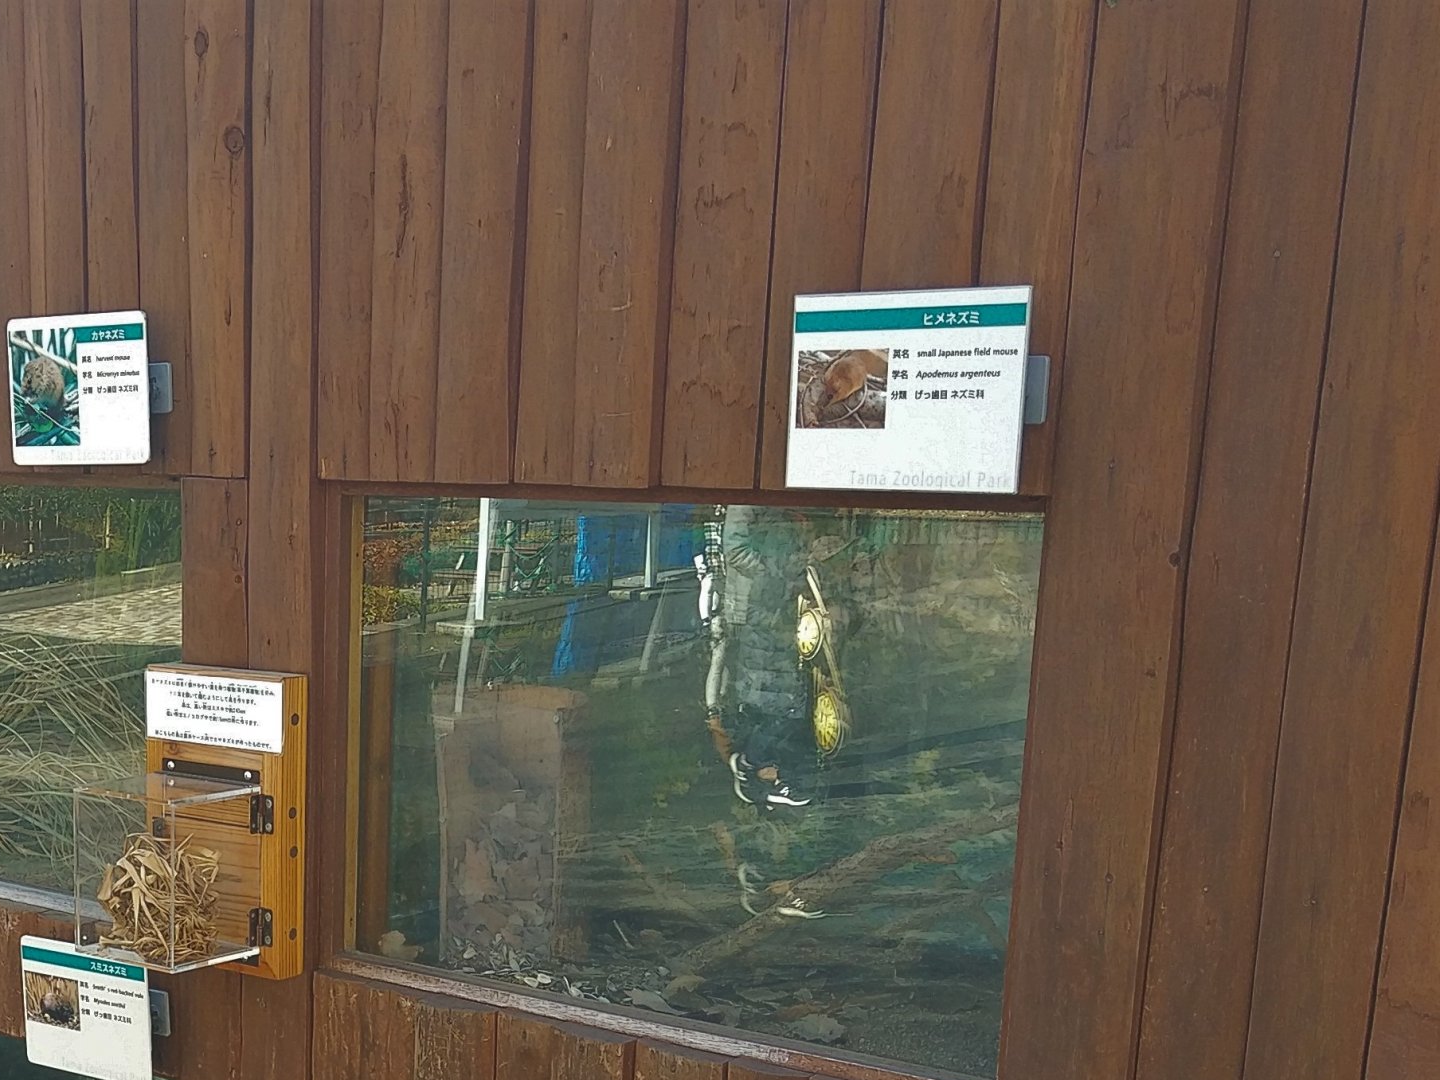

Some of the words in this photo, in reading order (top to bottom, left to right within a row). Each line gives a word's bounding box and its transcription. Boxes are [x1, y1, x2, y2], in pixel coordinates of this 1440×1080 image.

[923, 311, 980, 326] ヒメネズミ
[91, 328, 125, 341] カヤネズミ
[892, 349, 909, 359] 英名
[917, 348, 937, 358] small
[938, 348, 972, 359] Japanese
[974, 347, 991, 356] field
[993, 348, 1018, 356] mouse
[892, 370, 909, 379] 学名
[915, 369, 958, 380] Apodemus
[960, 369, 1001, 379] argenteus
[891, 391, 907, 400] 分類
[915, 390, 948, 400] げっ歯目
[950, 389, 985, 399] ネズミ科
[850, 470, 887, 486] Tama
[892, 470, 971, 488] Zoological
[977, 472, 1011, 488] Park
[90, 961, 127, 977] スミスネズミ
